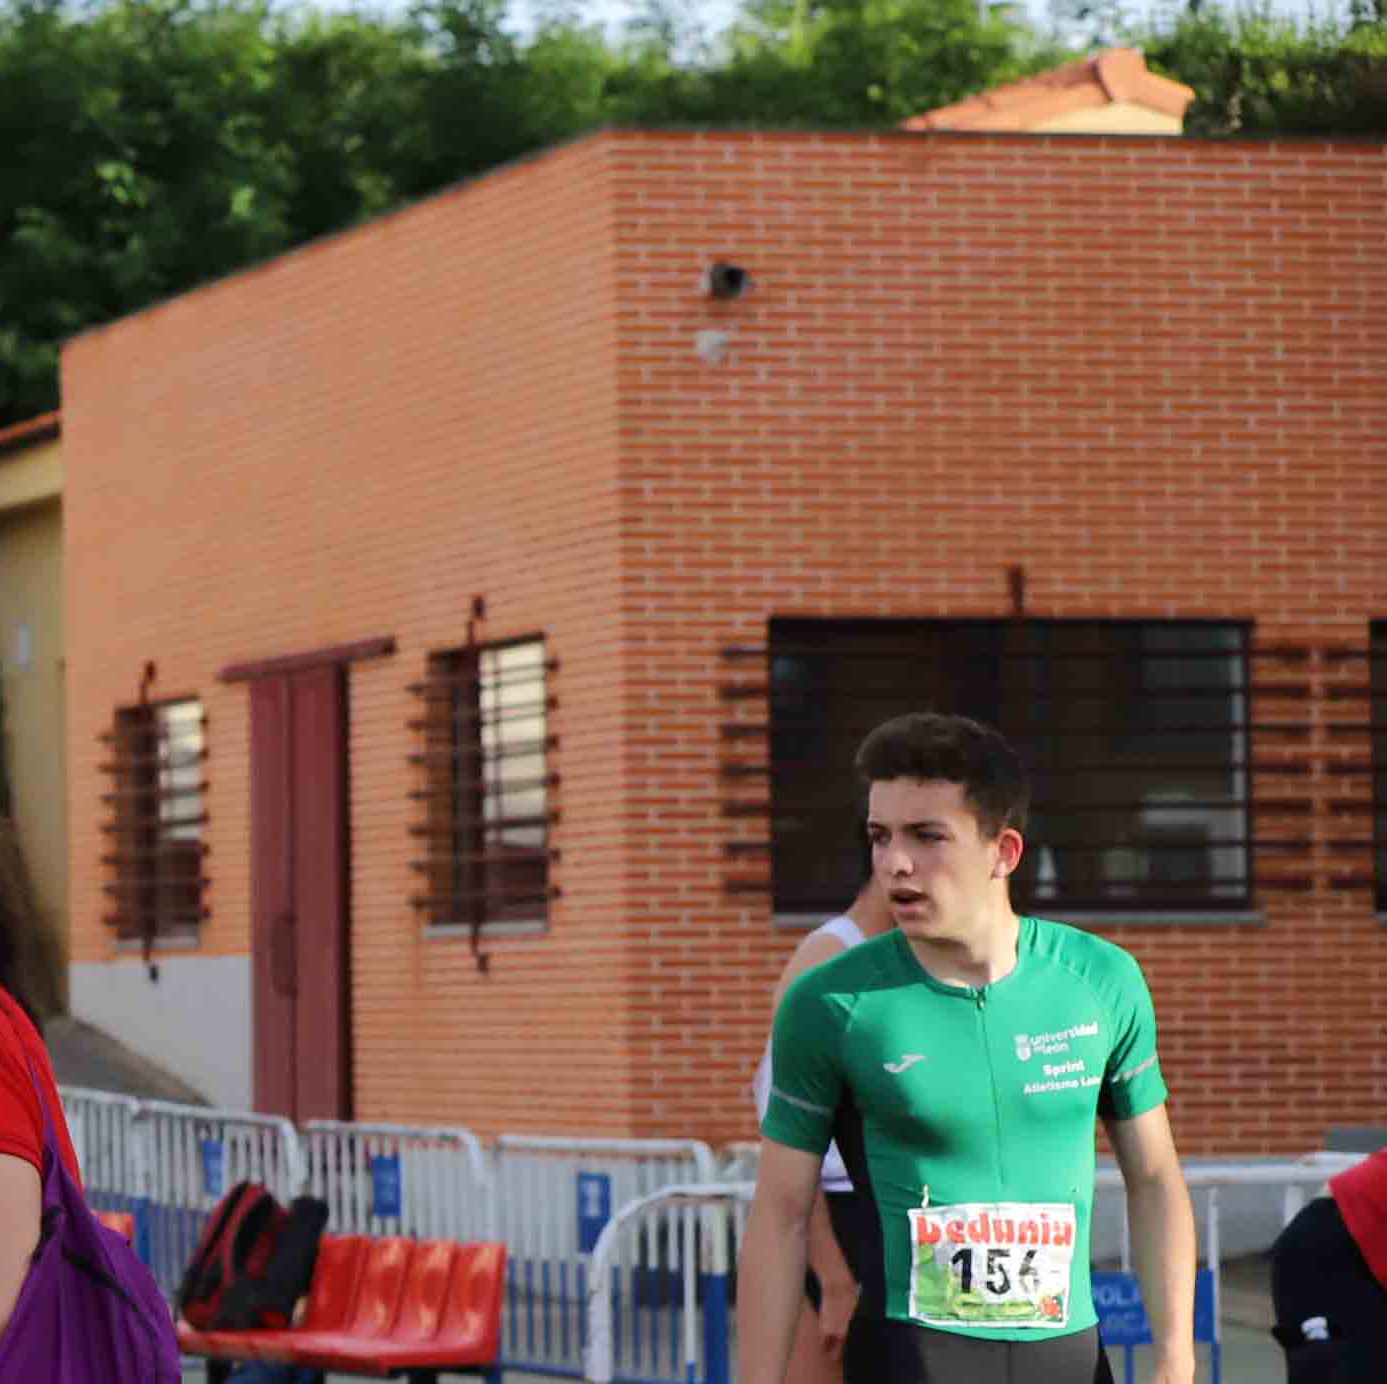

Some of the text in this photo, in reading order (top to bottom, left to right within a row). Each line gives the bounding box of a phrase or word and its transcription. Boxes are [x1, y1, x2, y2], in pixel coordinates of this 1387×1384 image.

[1042, 1059, 1086, 1077] Sprint
[916, 1212, 1073, 1248] bedunia
[951, 1248, 1040, 1295] 156
